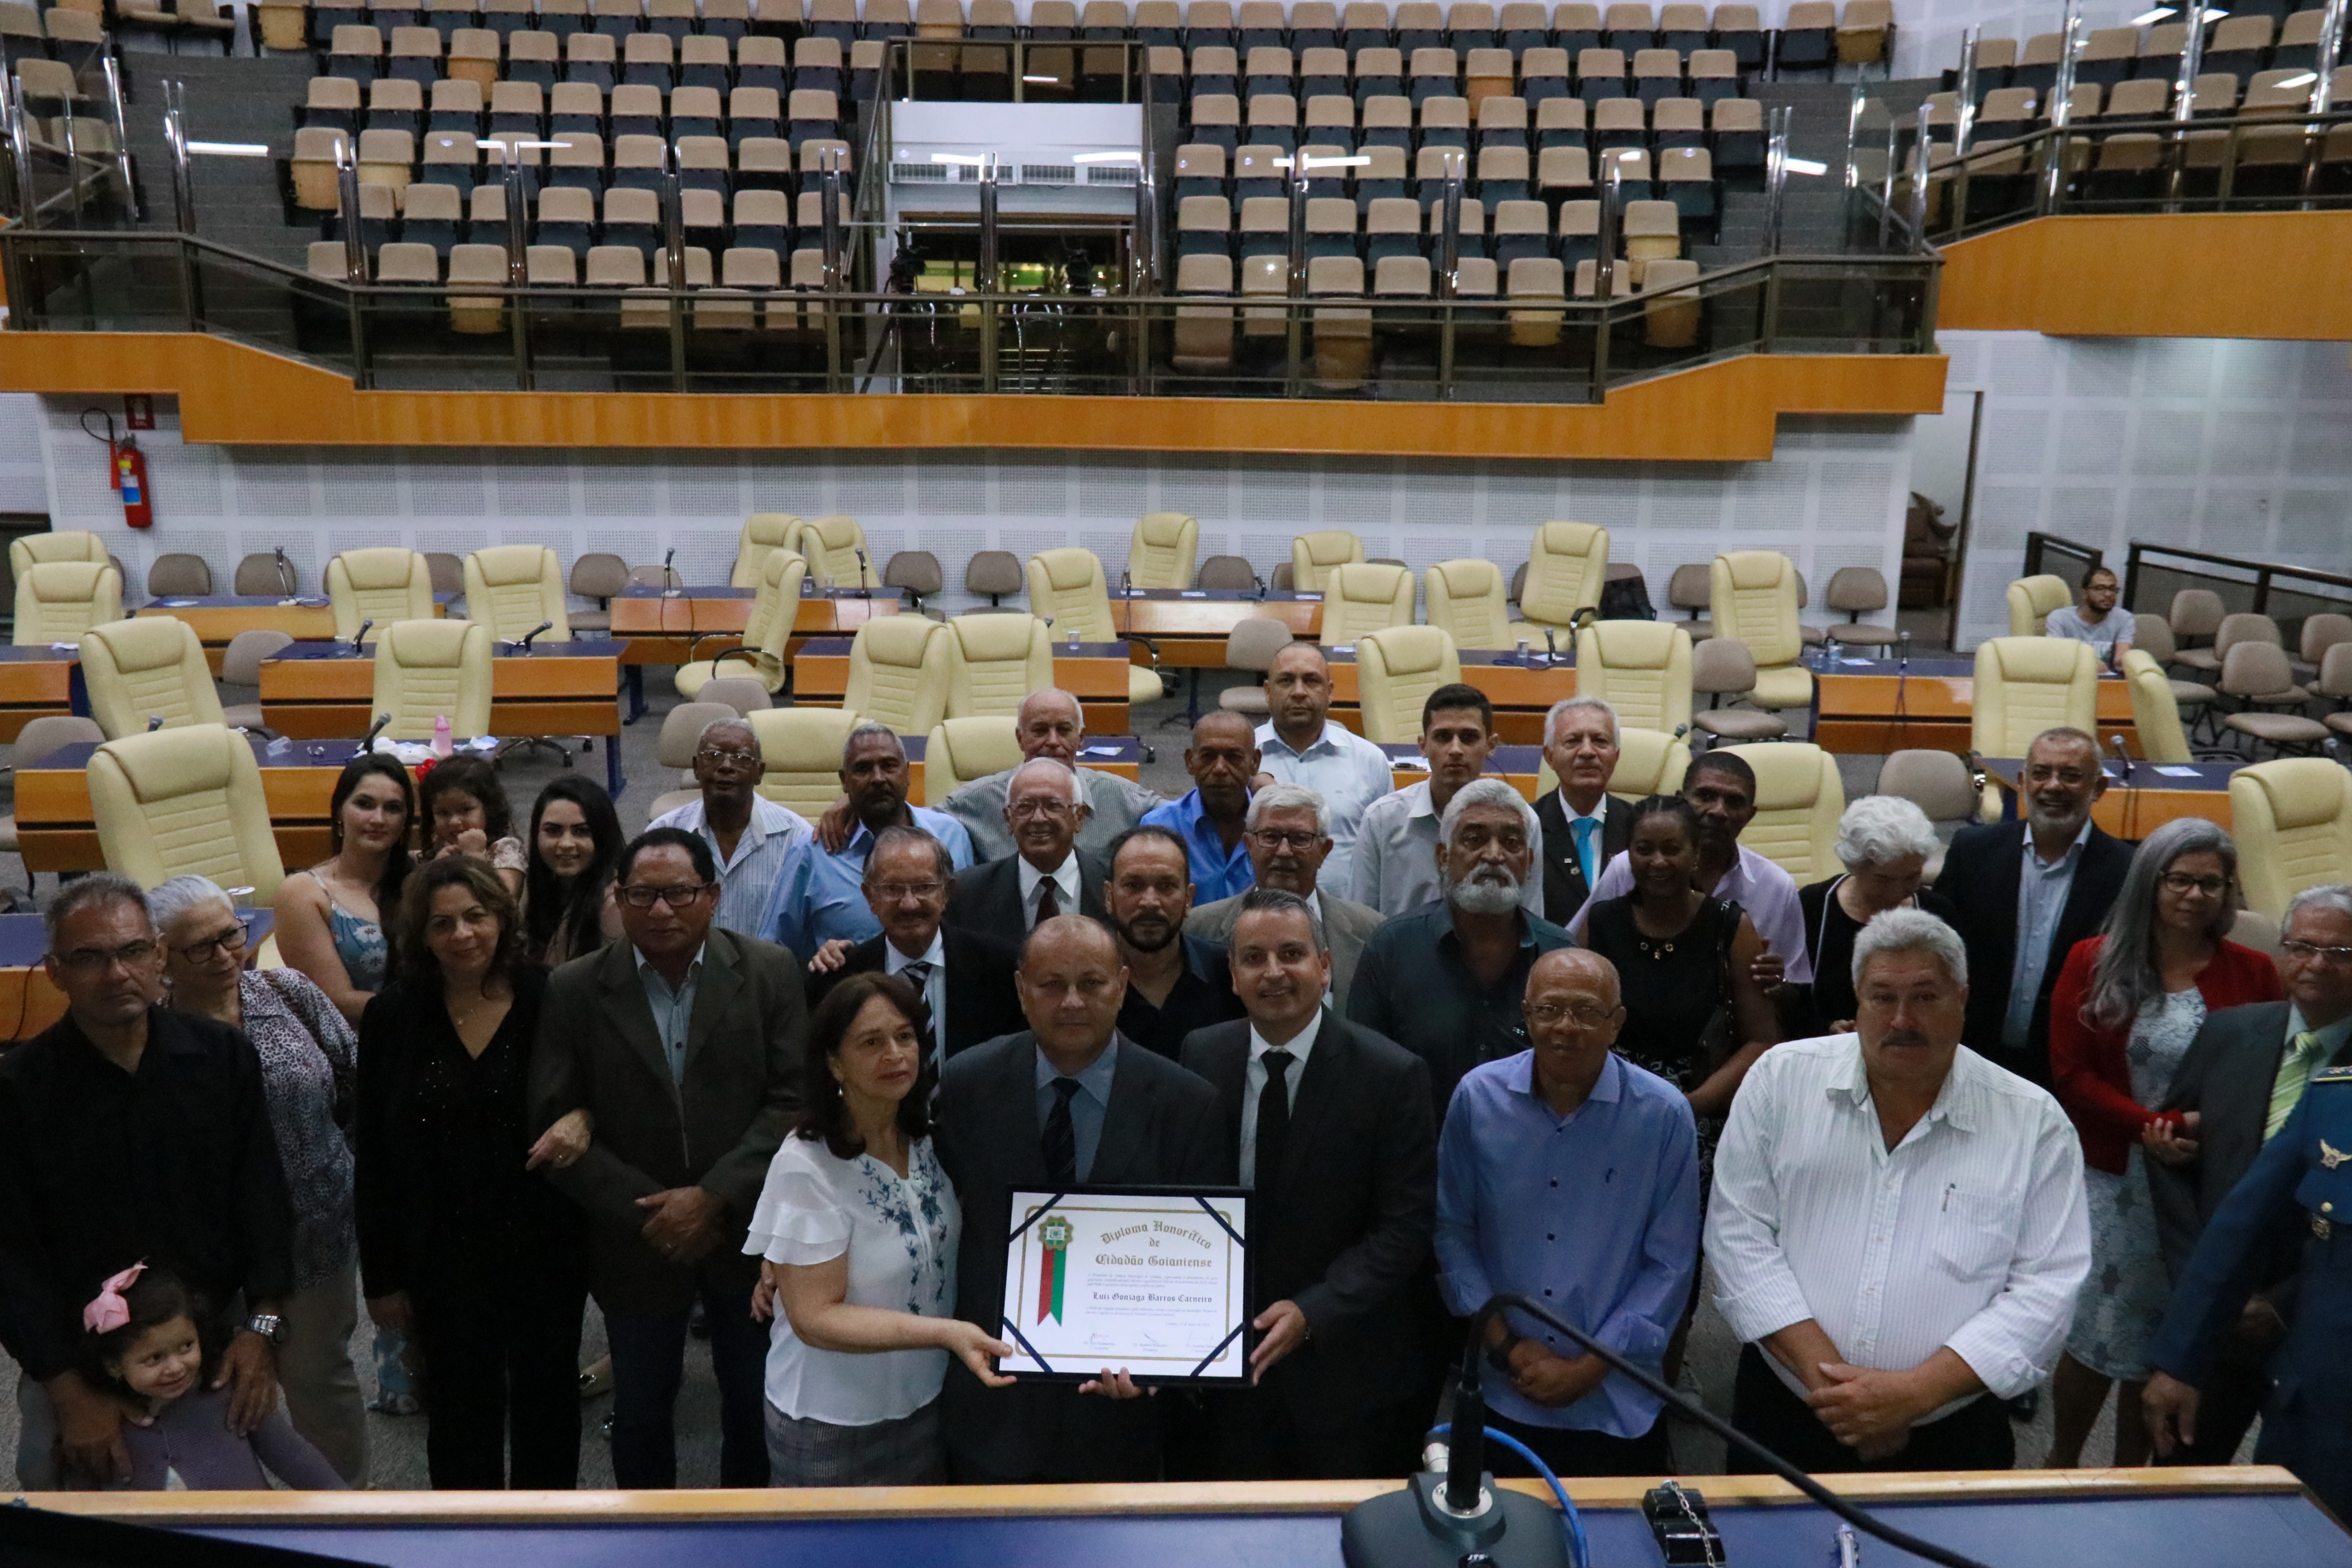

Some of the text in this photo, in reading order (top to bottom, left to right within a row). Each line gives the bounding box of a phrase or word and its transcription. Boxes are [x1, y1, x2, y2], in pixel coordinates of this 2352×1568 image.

[1100, 1220, 1212, 1250] Diploma Honorífico
[1149, 1238, 1160, 1247] de
[1095, 1253, 1212, 1268] Cidadão Goianiense
[1112, 1292, 1145, 1302] Gonzaga
[1148, 1293, 1176, 1302] Barros
[1178, 1294, 1212, 1302] Carneiro
